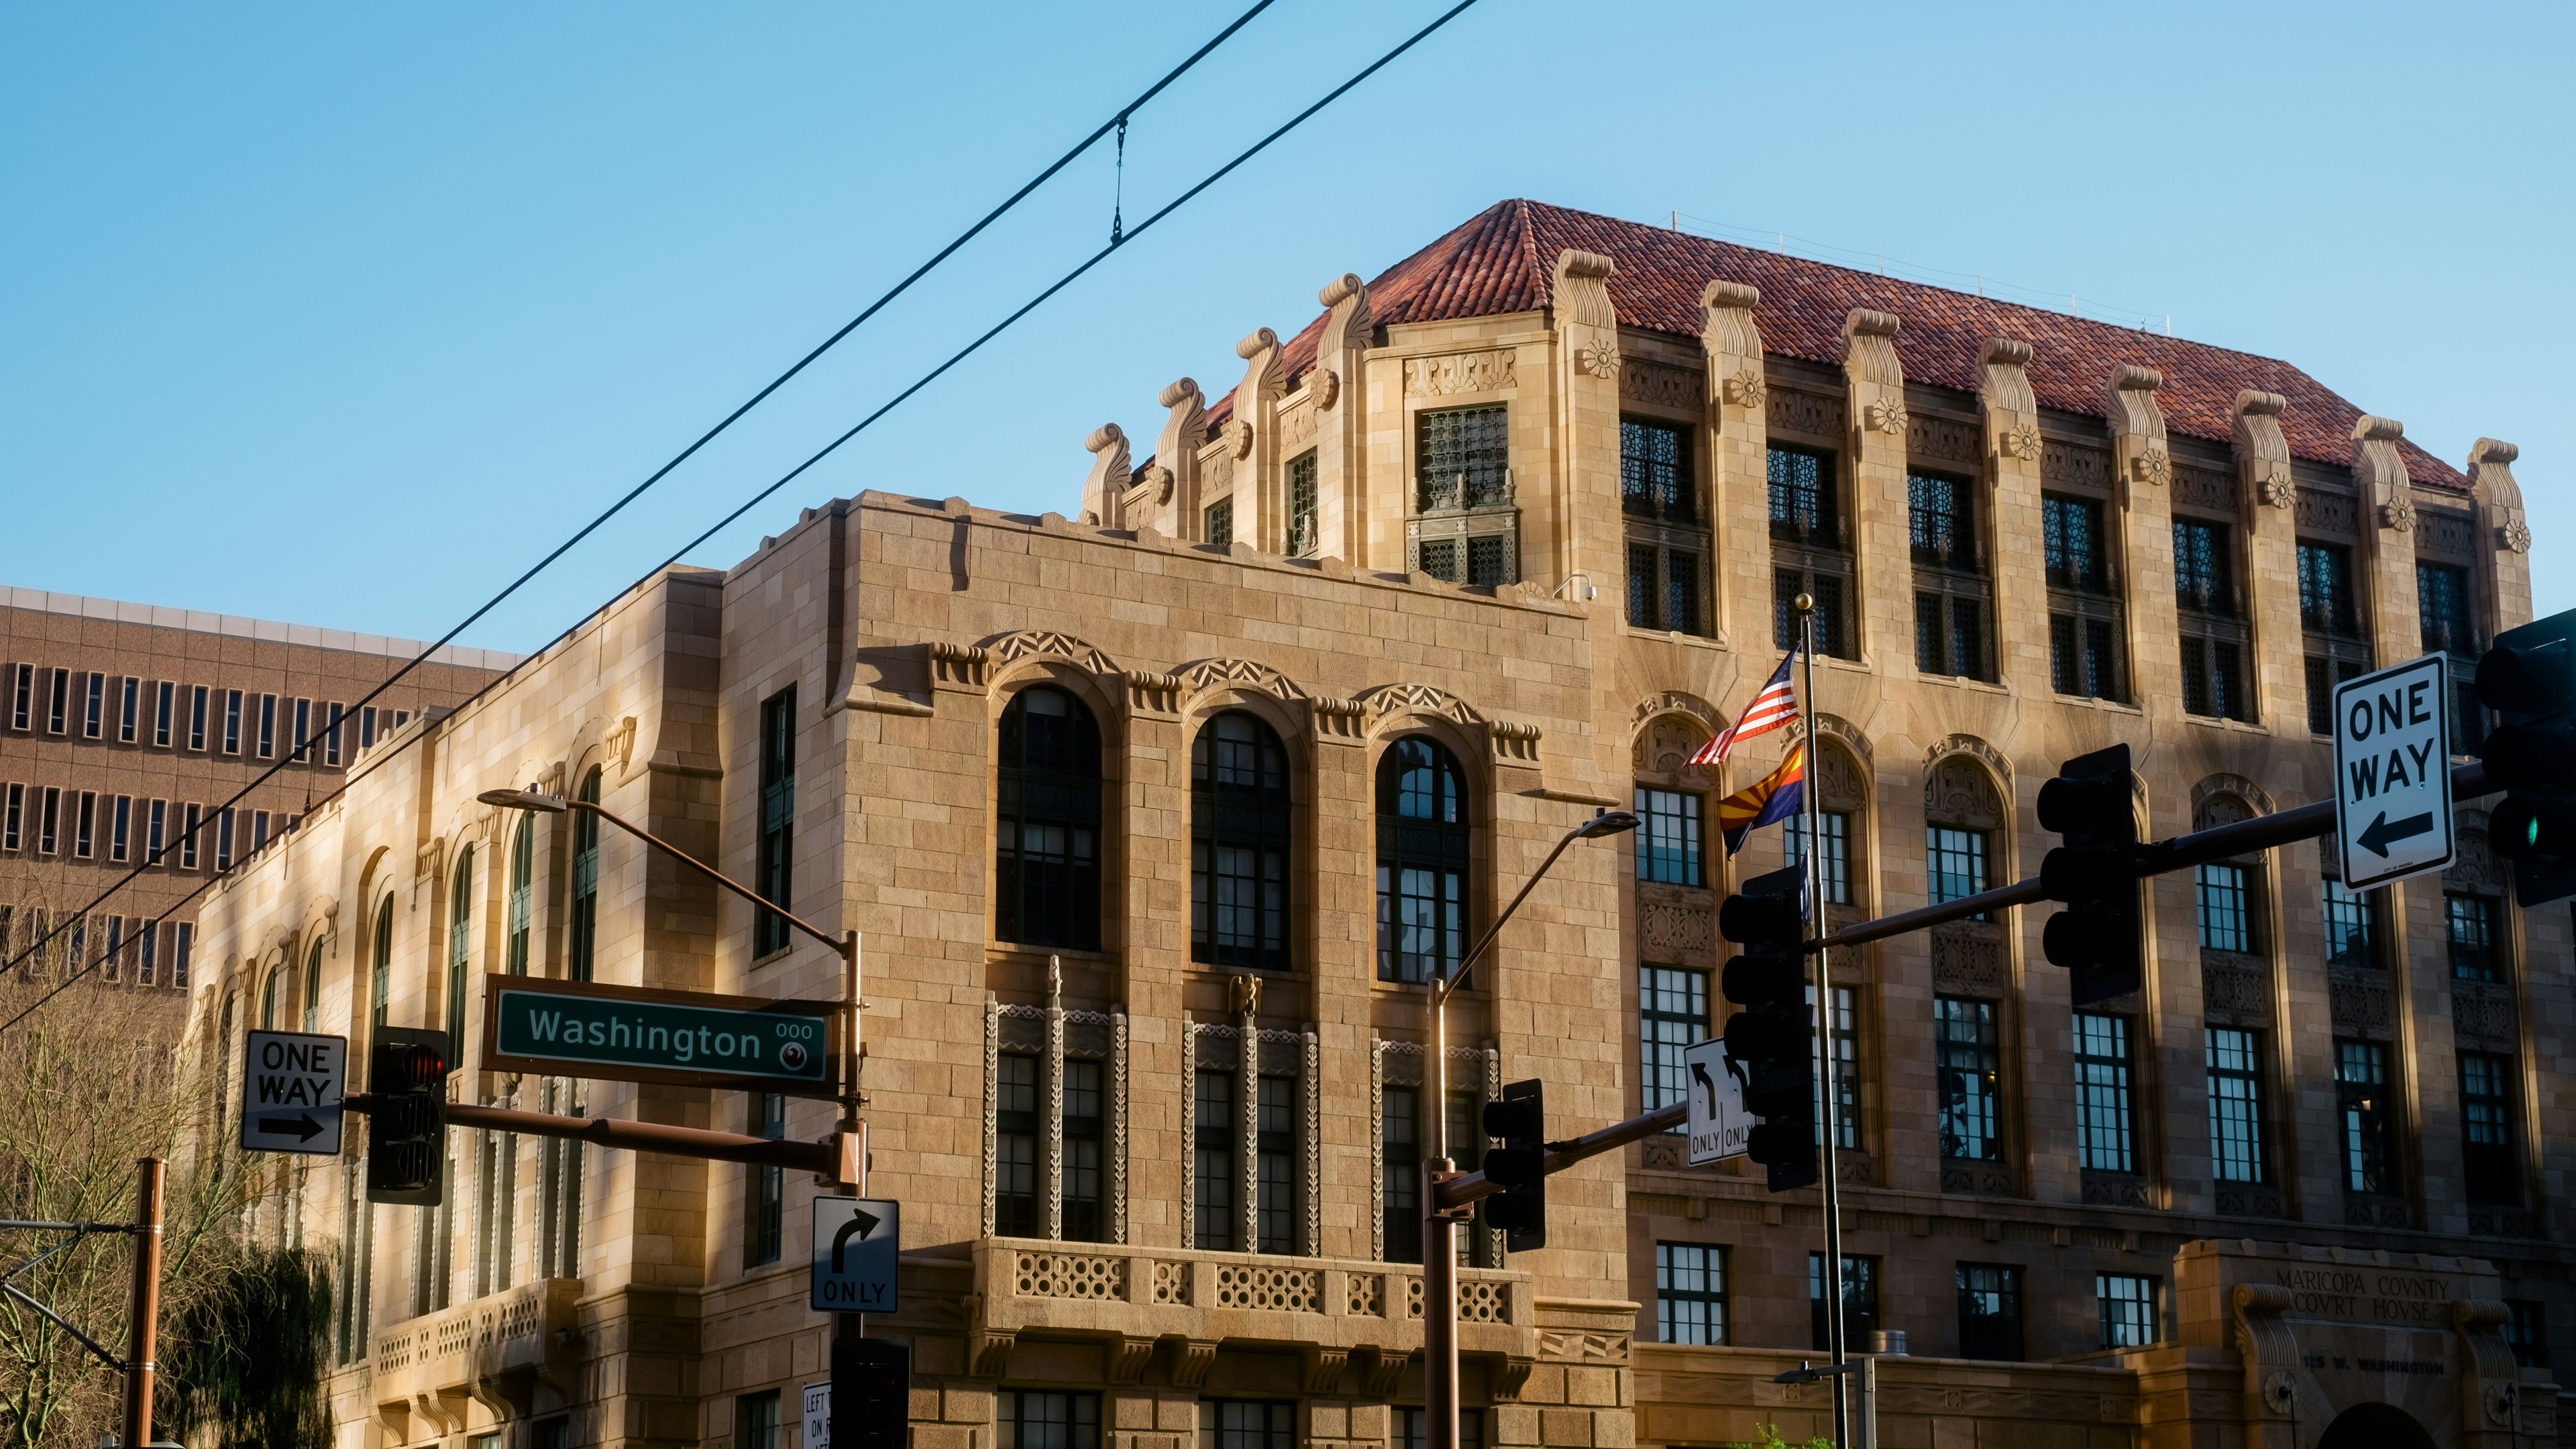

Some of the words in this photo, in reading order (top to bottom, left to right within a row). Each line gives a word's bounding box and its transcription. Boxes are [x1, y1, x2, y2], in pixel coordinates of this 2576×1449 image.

[2350, 680, 2430, 742] ONE
[2350, 737, 2434, 802] WAY
[529, 1010, 761, 1061] Washington
[776, 1023, 812, 1039] 000
[262, 1041, 330, 1073] ONE
[258, 1075, 331, 1106] WAY
[1693, 1132, 1719, 1155] ONLY
[824, 1280, 886, 1304] ONLY
[2276, 1268, 2367, 1294] MARICOPA
[2303, 1354, 2325, 1369] 125
[2358, 1358, 2445, 1375] WASHINGTON
[806, 1393, 825, 1413] LEFT
[812, 1419, 822, 1438] ON
